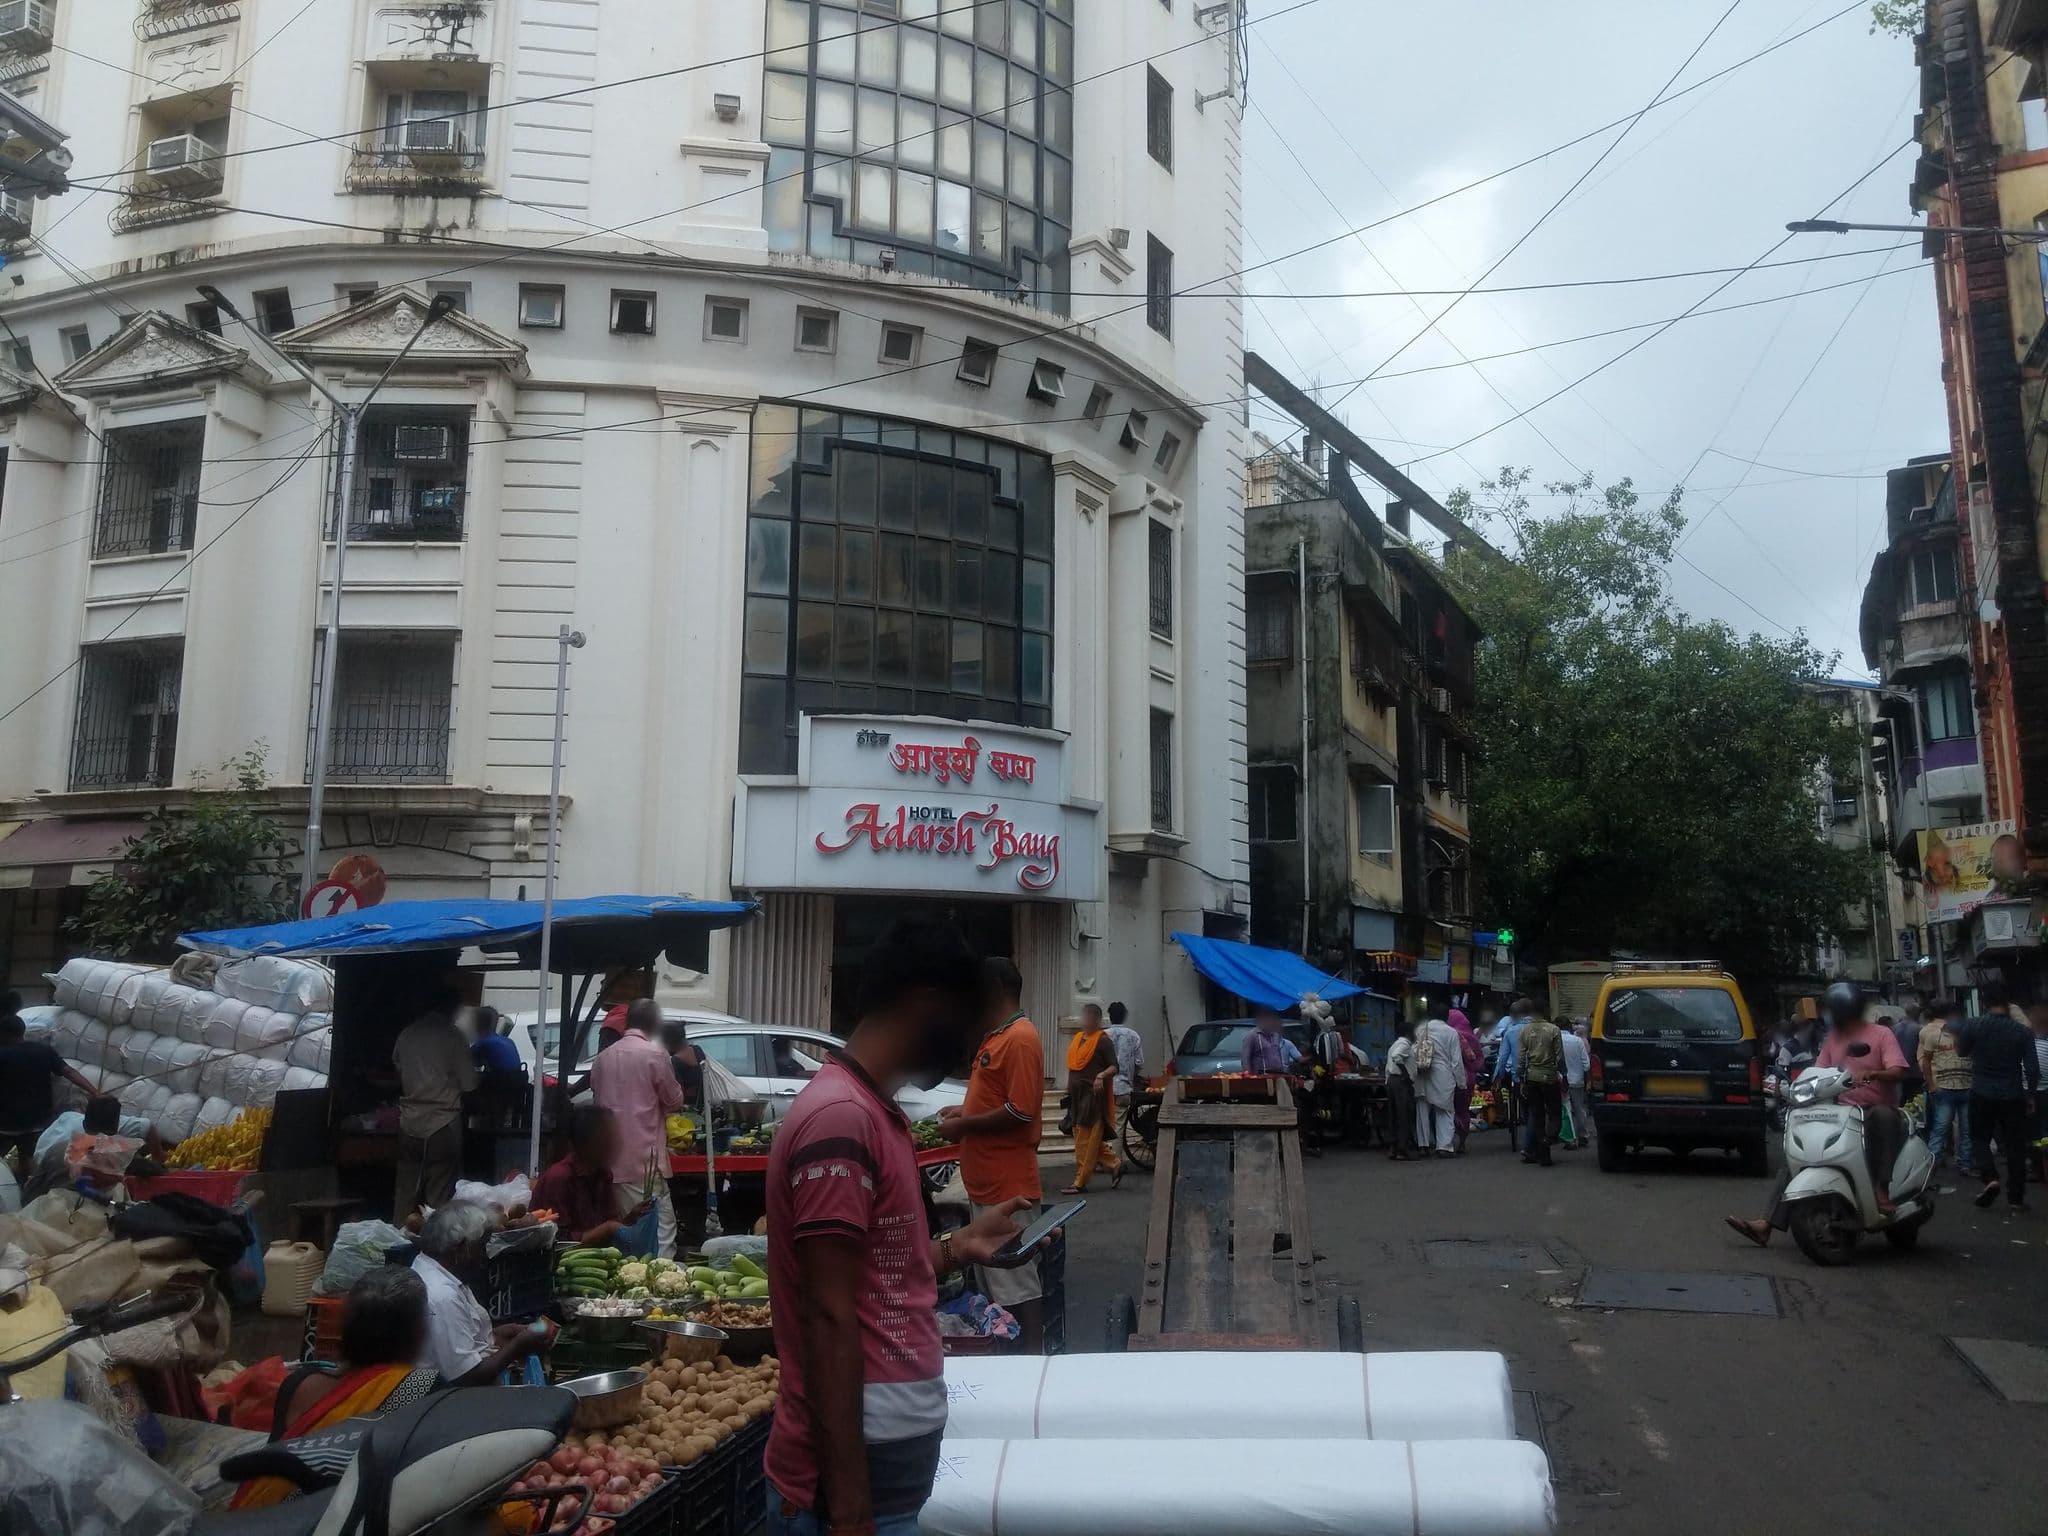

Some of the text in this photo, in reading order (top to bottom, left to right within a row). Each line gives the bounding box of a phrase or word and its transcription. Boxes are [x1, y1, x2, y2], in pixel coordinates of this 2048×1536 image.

[889, 736, 1037, 784] आदर्श बाग
[910, 806, 957, 820] HOTEL
[815, 803, 1061, 891] Adarsh Baug
